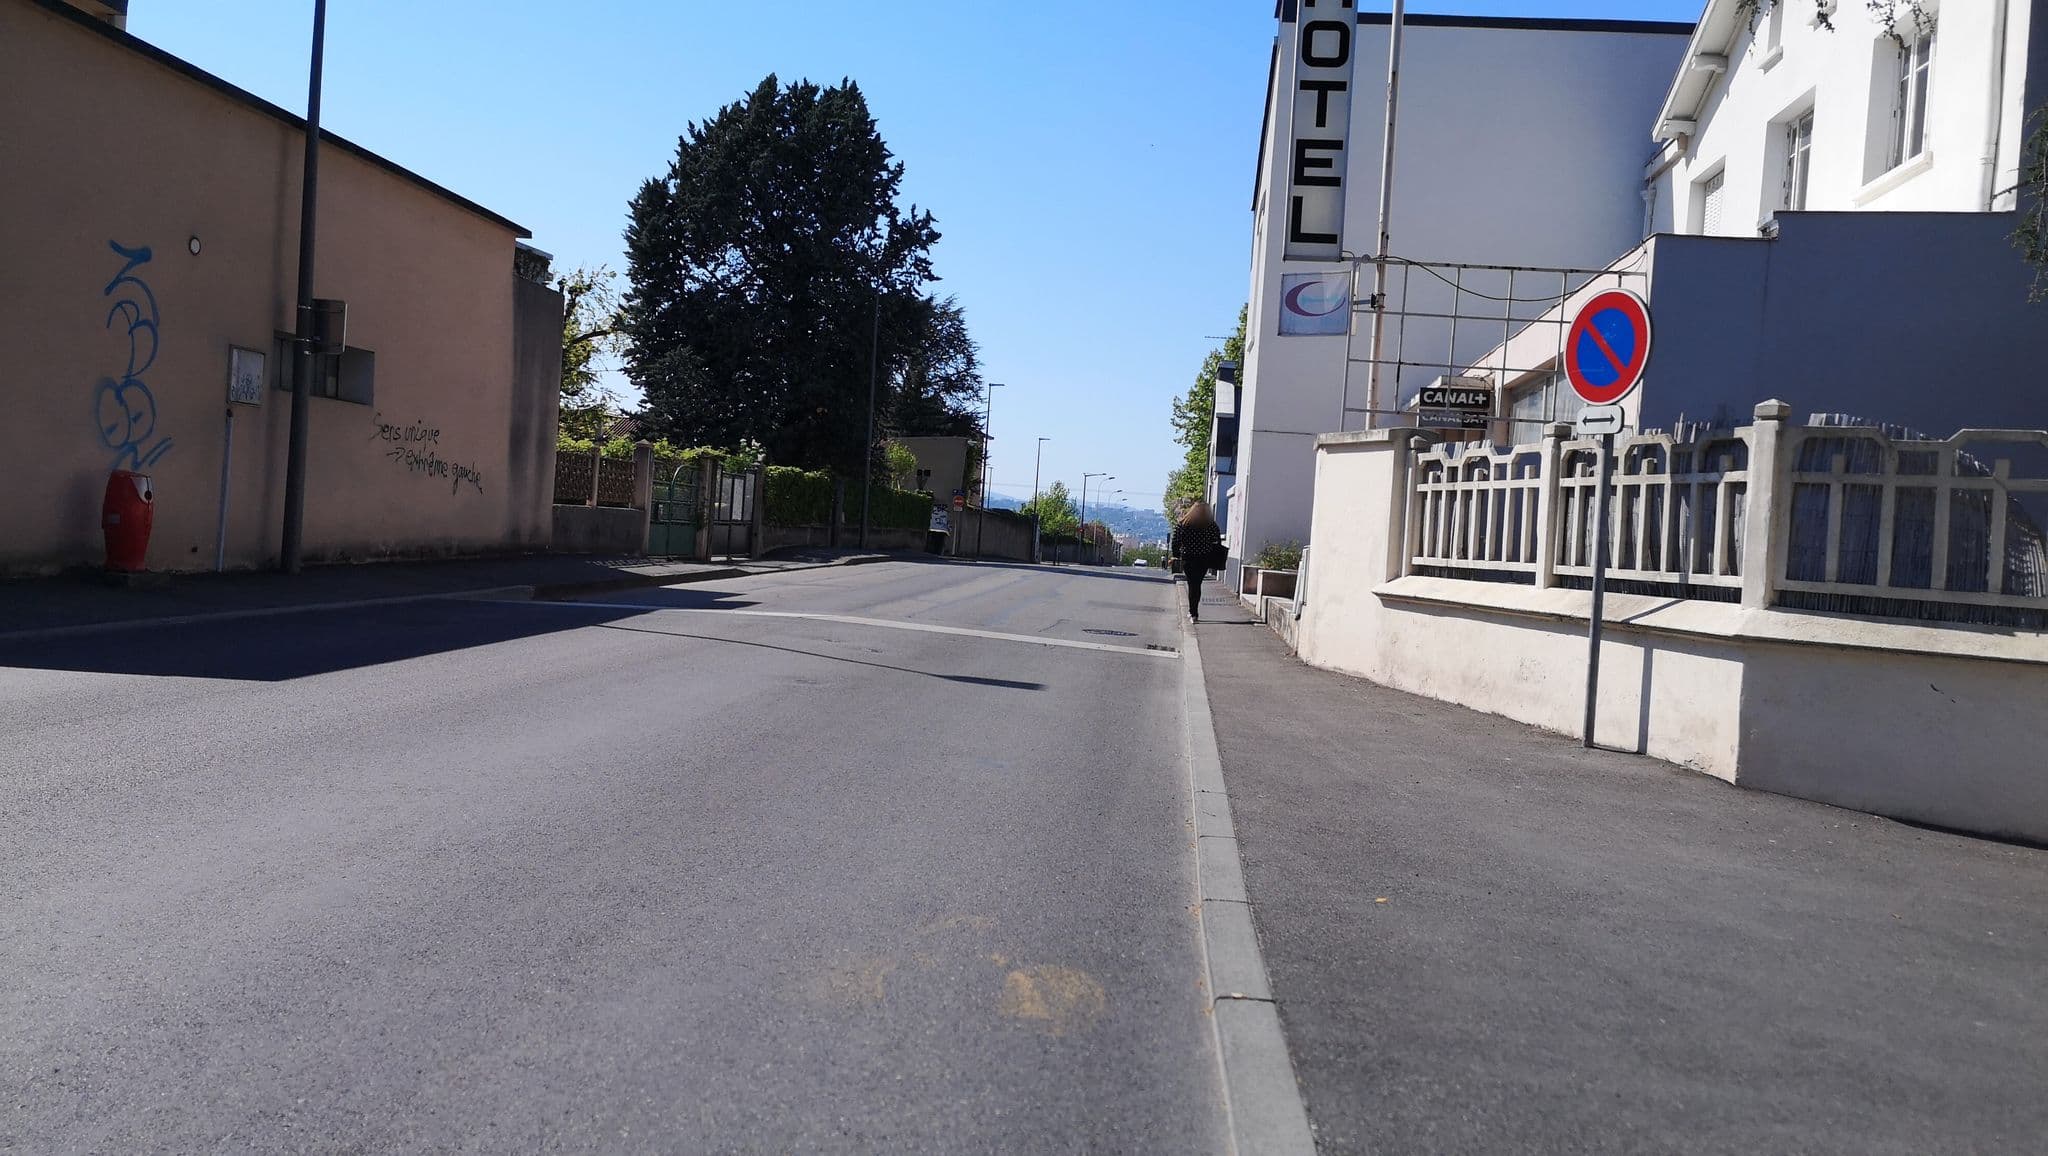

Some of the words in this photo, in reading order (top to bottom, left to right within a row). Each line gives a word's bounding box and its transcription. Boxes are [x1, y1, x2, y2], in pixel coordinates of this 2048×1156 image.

[1290, 0, 1352, 244] OTEL
[1423, 391, 1487, 405] CANAL+
[404, 419, 440, 450] unique
